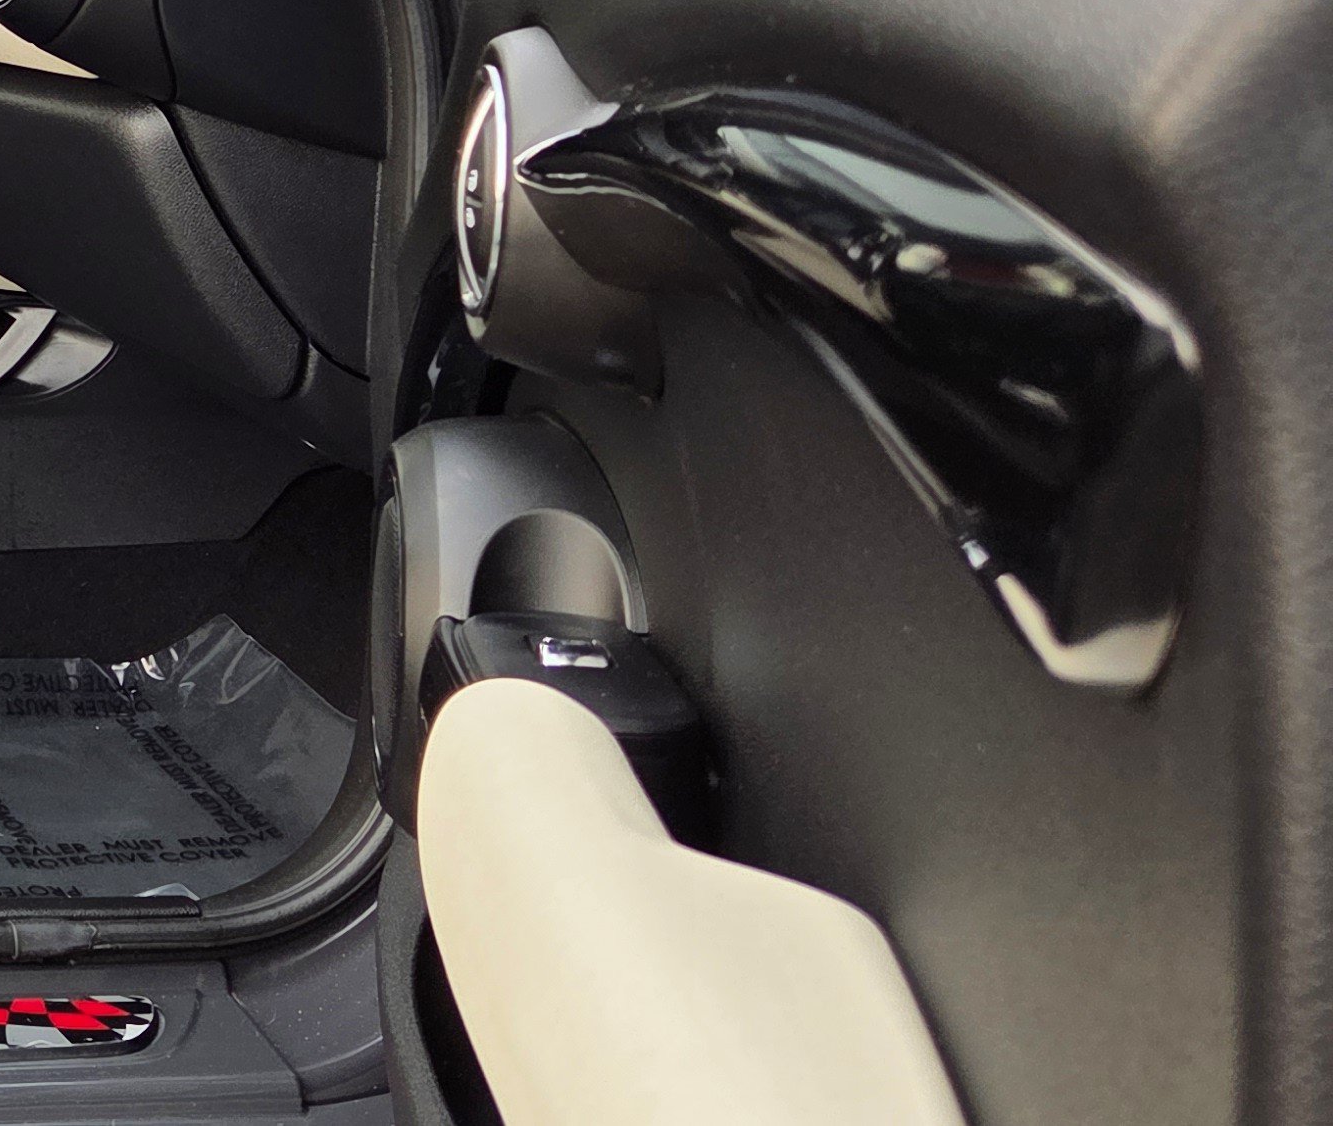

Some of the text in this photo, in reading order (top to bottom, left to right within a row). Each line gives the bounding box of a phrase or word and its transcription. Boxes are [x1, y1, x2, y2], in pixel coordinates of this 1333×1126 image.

[4, 698, 60, 716] MUST
[153, 725, 201, 762] COVER
[102, 838, 165, 852] MUST
[177, 826, 284, 850] REMOVE
[5, 847, 251, 870] PROTECTIVE COVER
